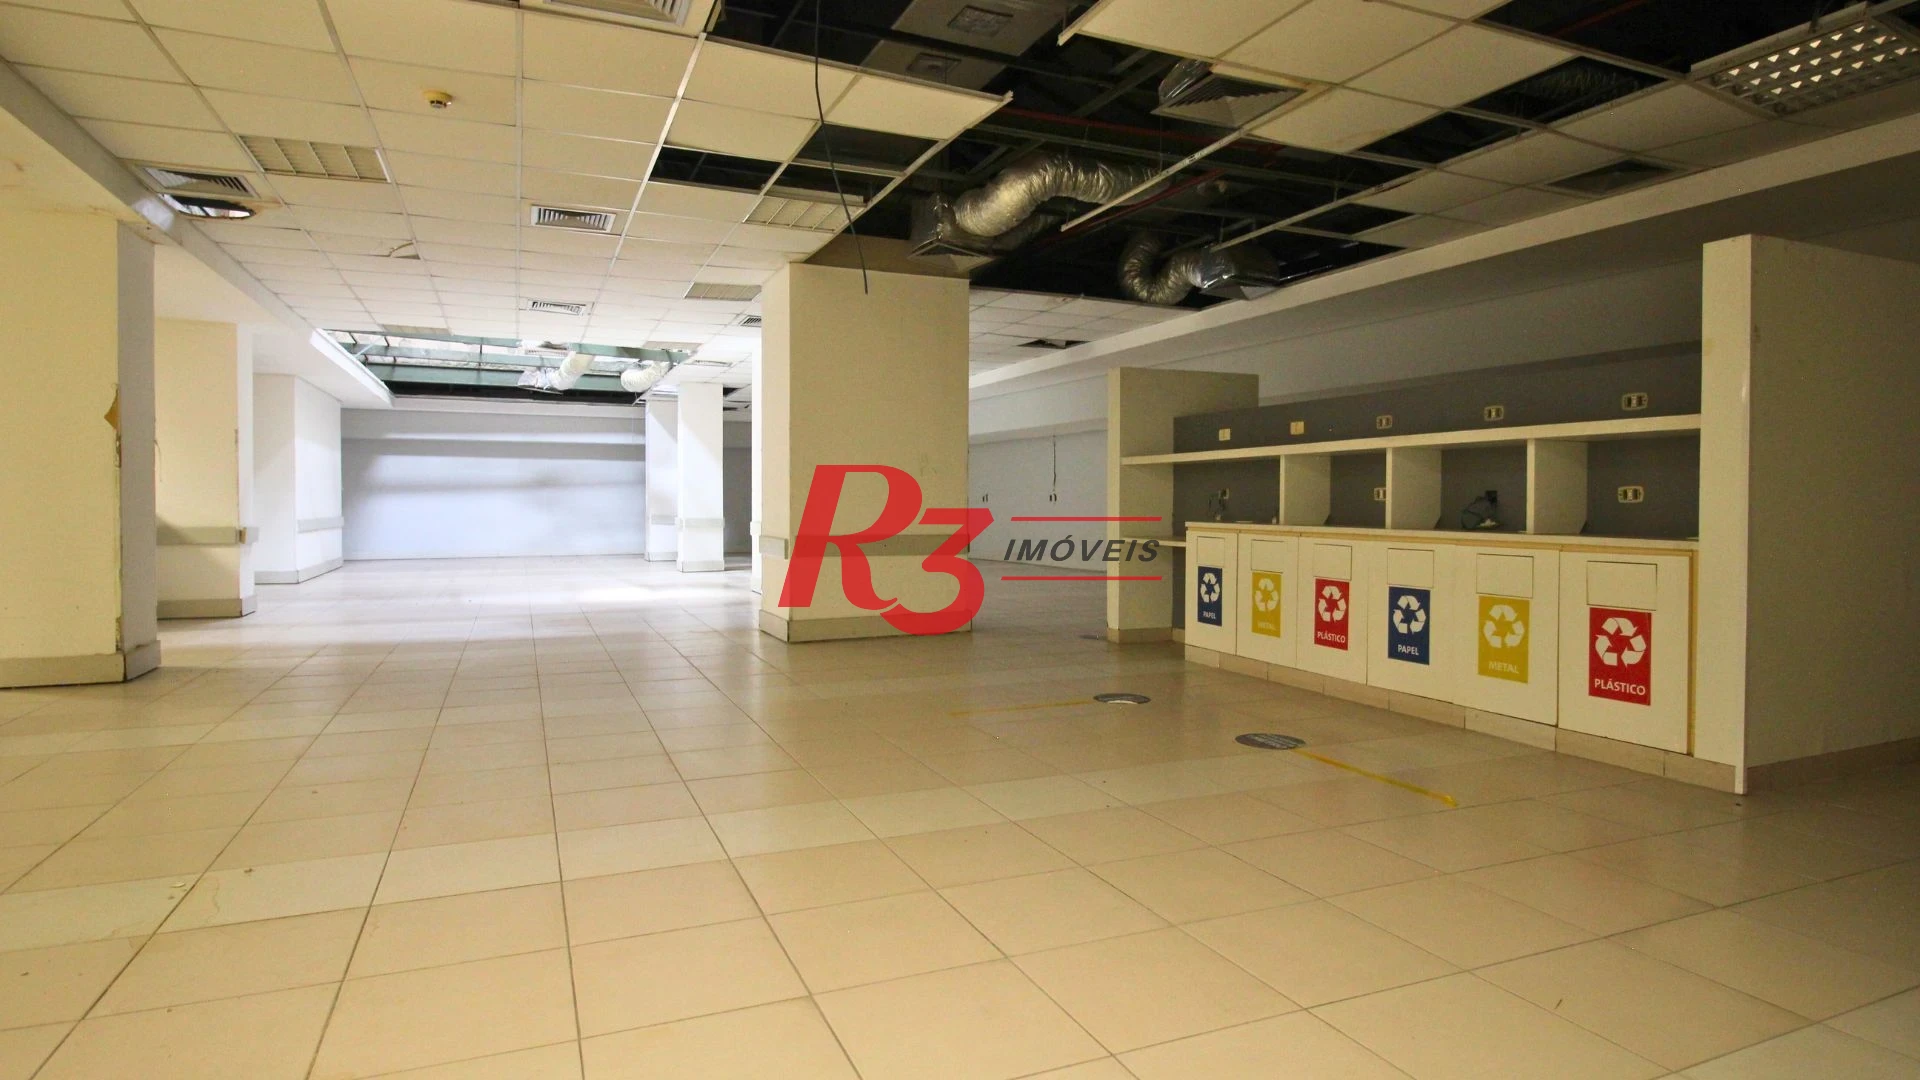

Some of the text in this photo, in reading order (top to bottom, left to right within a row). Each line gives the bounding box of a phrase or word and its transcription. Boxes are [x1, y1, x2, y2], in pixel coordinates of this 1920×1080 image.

[1203, 611, 1216, 620] PAPEL
[1317, 630, 1345, 643] PLÁSTICO
[1397, 644, 1419, 655] PAPEL
[1489, 660, 1519, 674] METAL
[1594, 678, 1646, 696] PLÁSTICO
